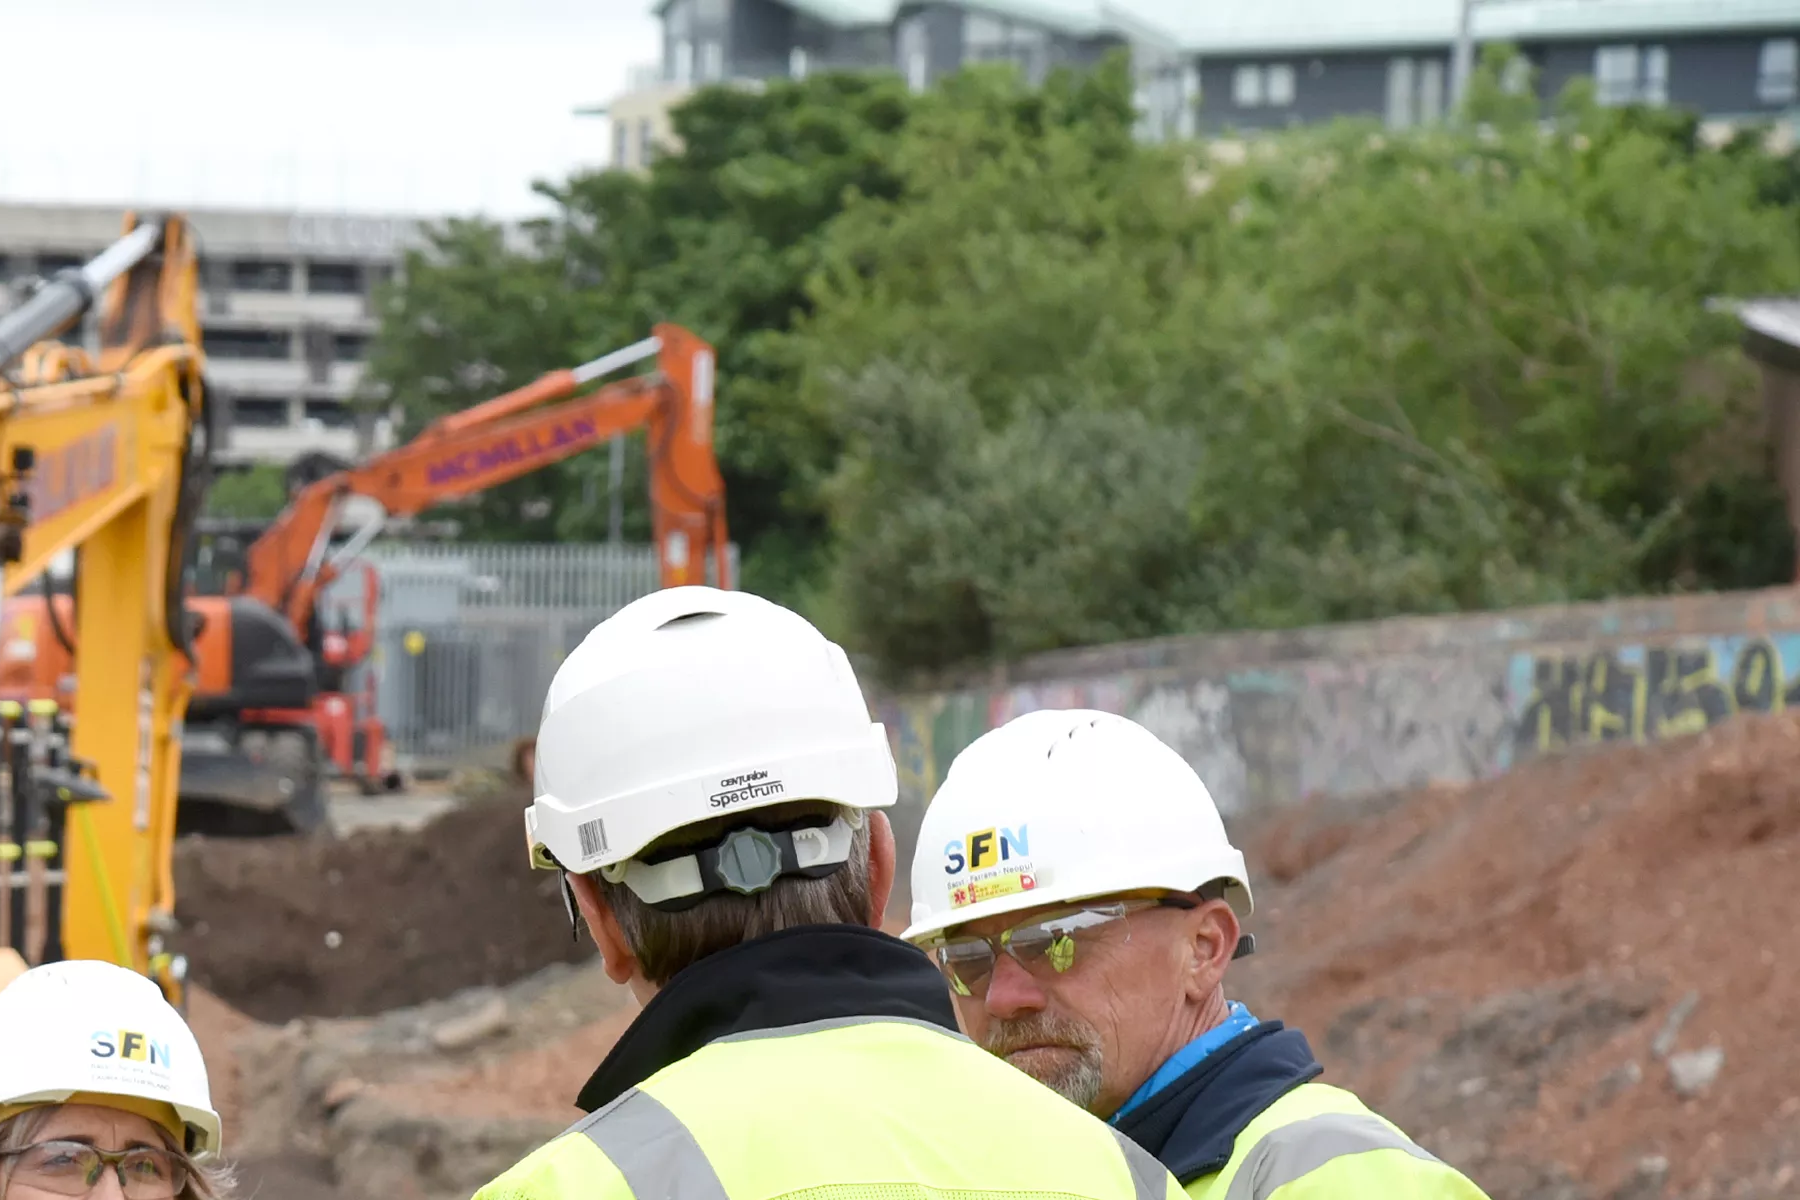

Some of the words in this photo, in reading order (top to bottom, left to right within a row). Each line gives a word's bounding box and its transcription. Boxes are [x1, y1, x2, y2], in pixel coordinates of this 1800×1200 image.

[709, 781, 784, 808] Spectrum
[944, 824, 1029, 875] SFN
[90, 1029, 171, 1069] SFN
